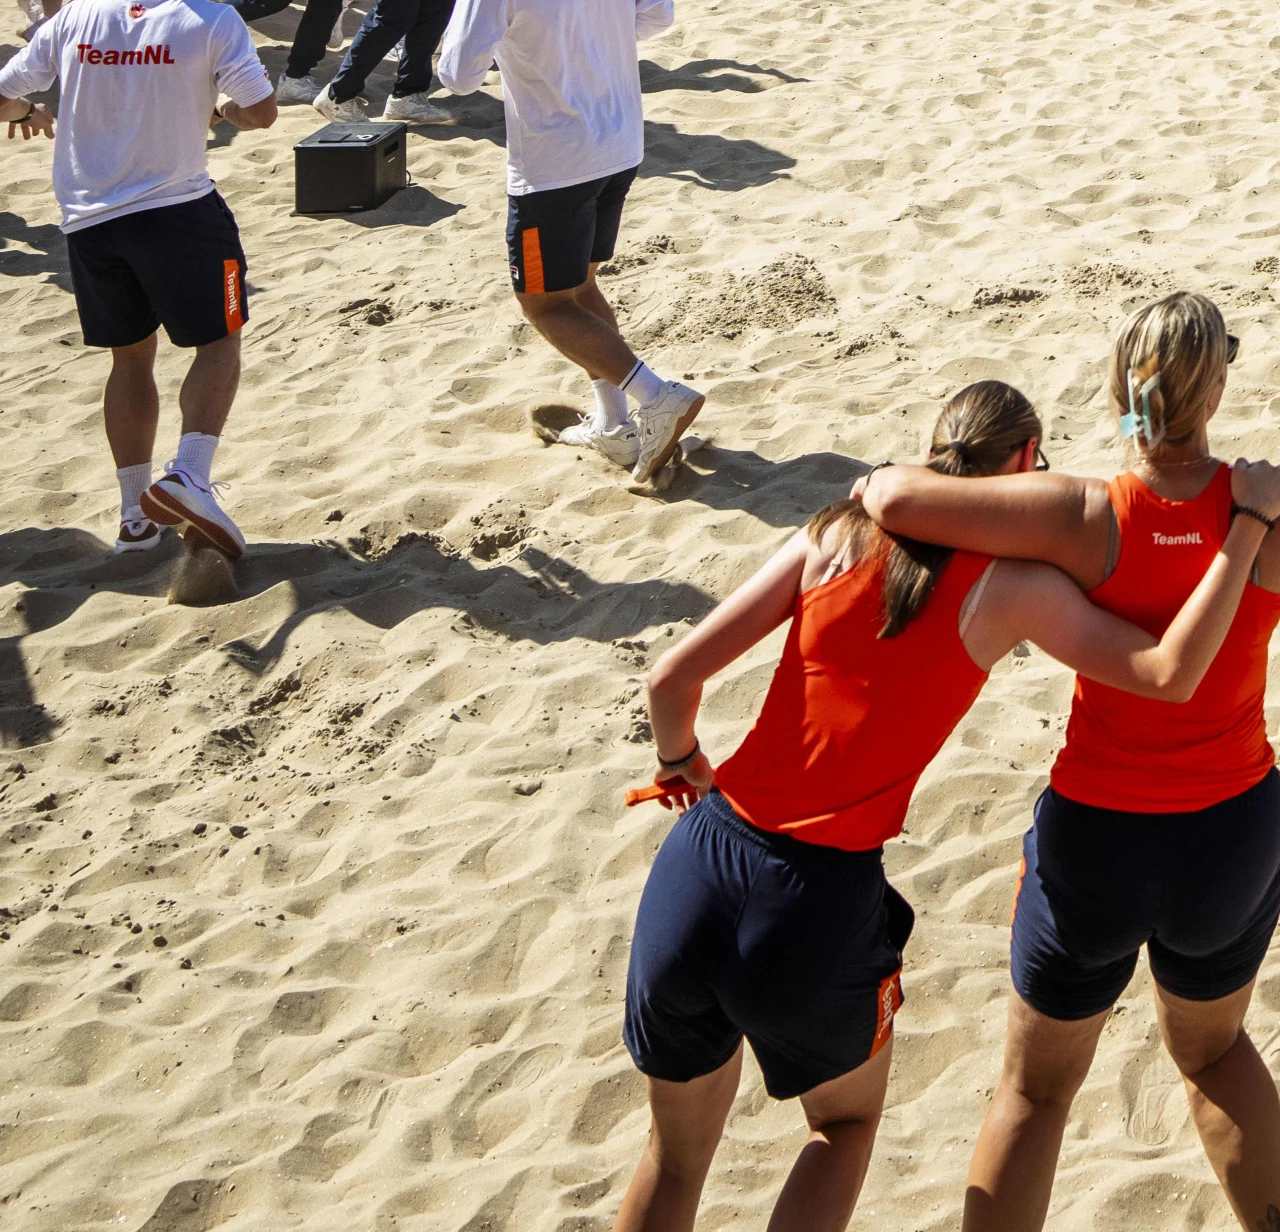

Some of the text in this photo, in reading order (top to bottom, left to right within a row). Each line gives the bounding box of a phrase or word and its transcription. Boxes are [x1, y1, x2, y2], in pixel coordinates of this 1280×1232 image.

[77, 43, 175, 66] TeamNL
[227, 271, 238, 314] TeamNL
[1152, 532, 1203, 545] TeamNL
